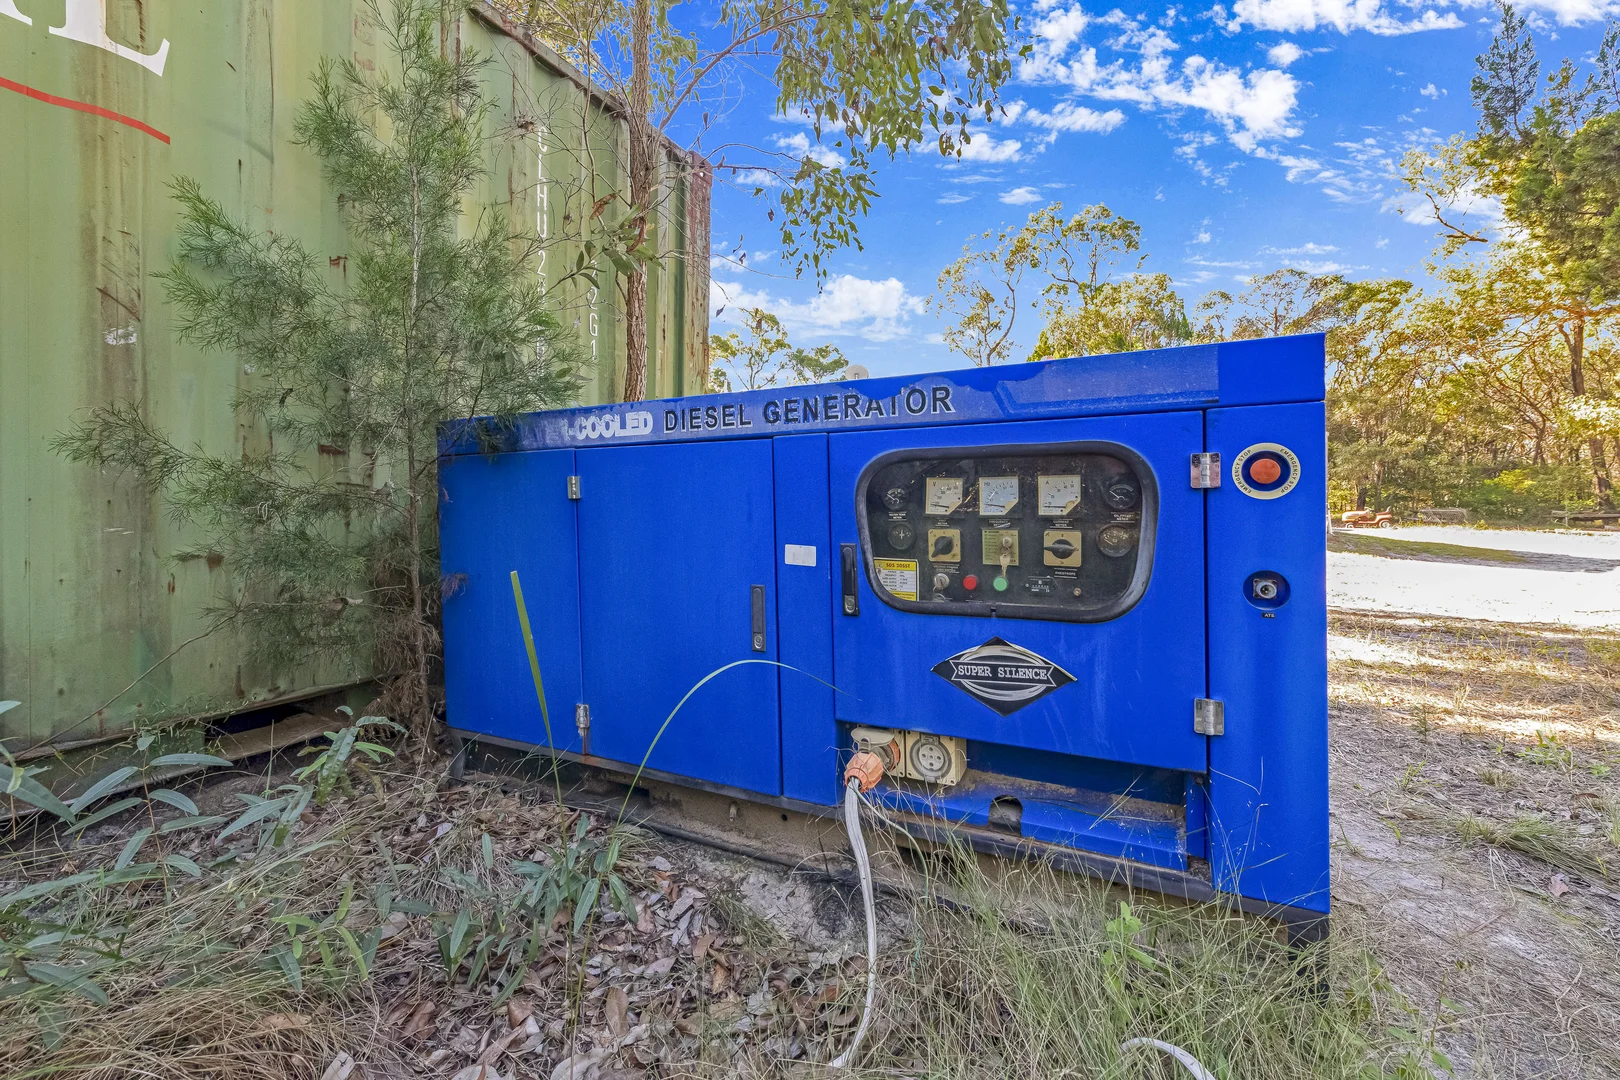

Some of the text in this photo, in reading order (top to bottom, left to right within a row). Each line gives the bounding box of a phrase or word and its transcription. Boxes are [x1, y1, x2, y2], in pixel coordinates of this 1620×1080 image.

[663, 402, 752, 434] DIESEL
[762, 386, 956, 424] GENERATOR
[958, 664, 1048, 680] SUPER SILENCE
